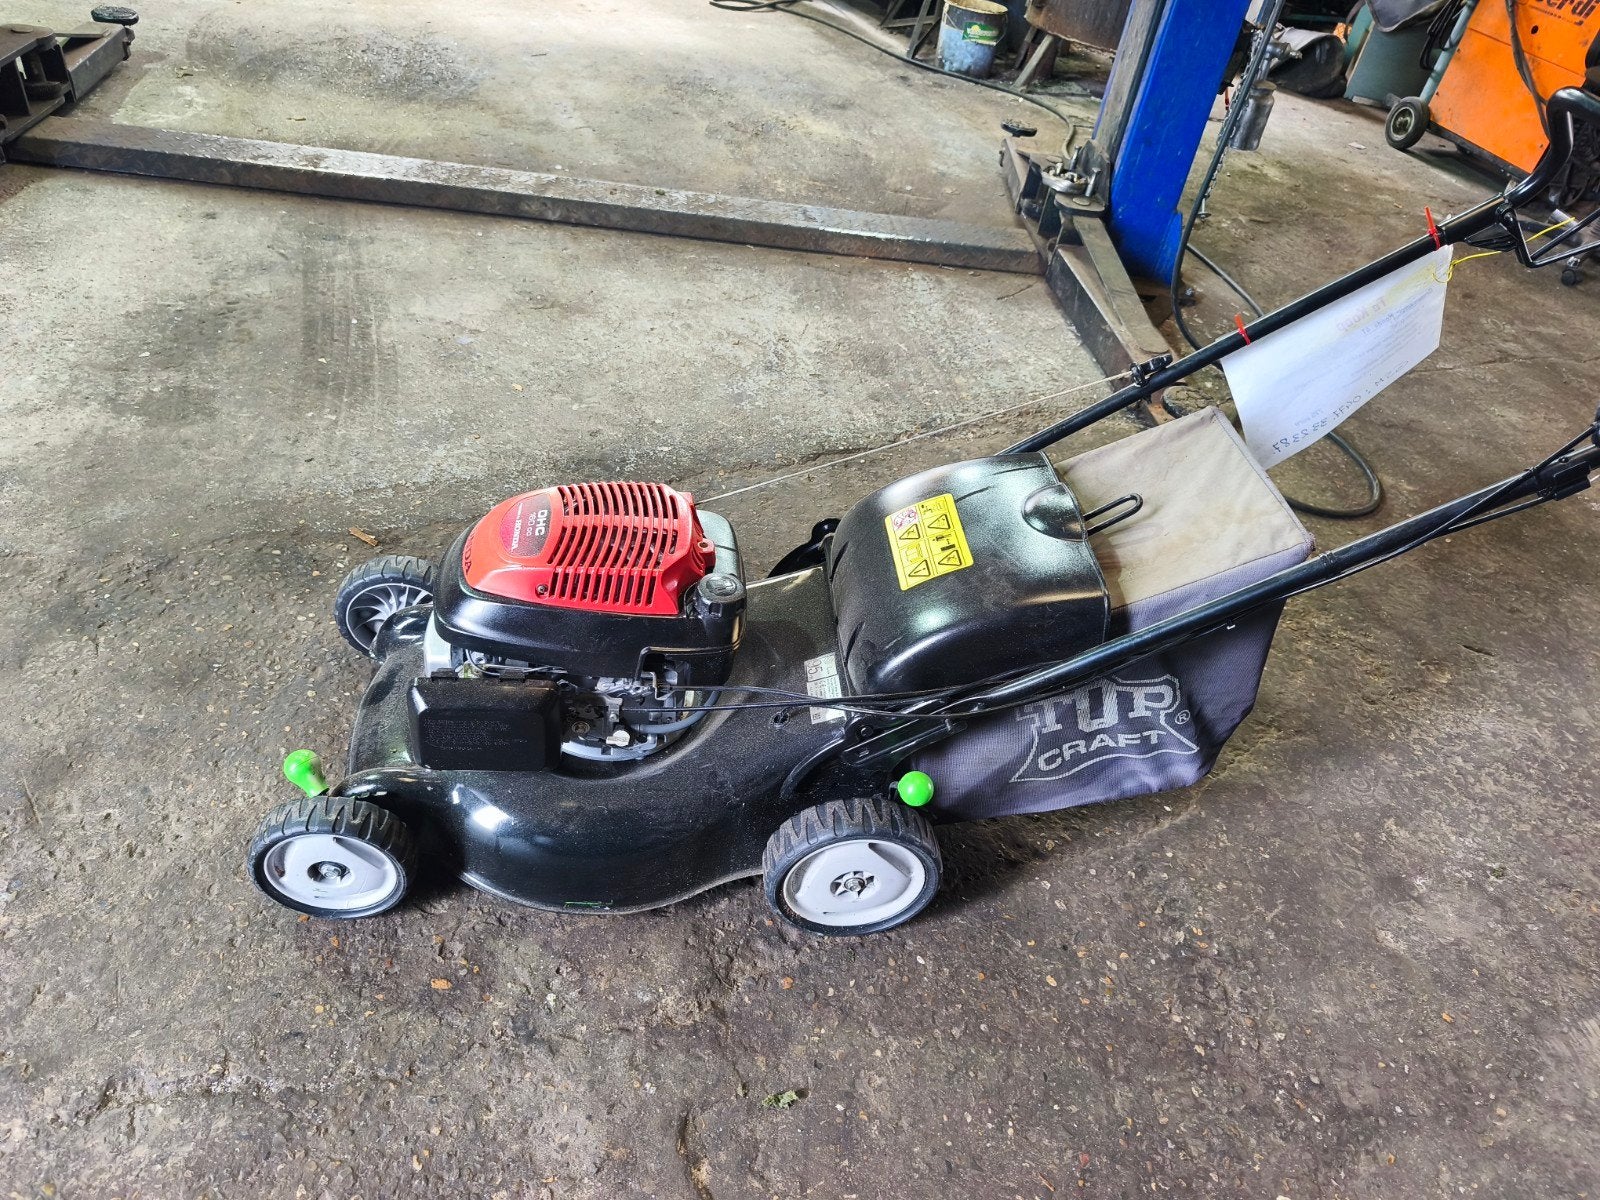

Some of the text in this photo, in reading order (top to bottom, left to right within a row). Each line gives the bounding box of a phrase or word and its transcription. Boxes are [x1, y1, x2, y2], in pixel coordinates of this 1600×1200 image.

[511, 518, 522, 552] HONDA
[536, 509, 548, 536] OHC
[1037, 729, 1168, 772] CRAFT
